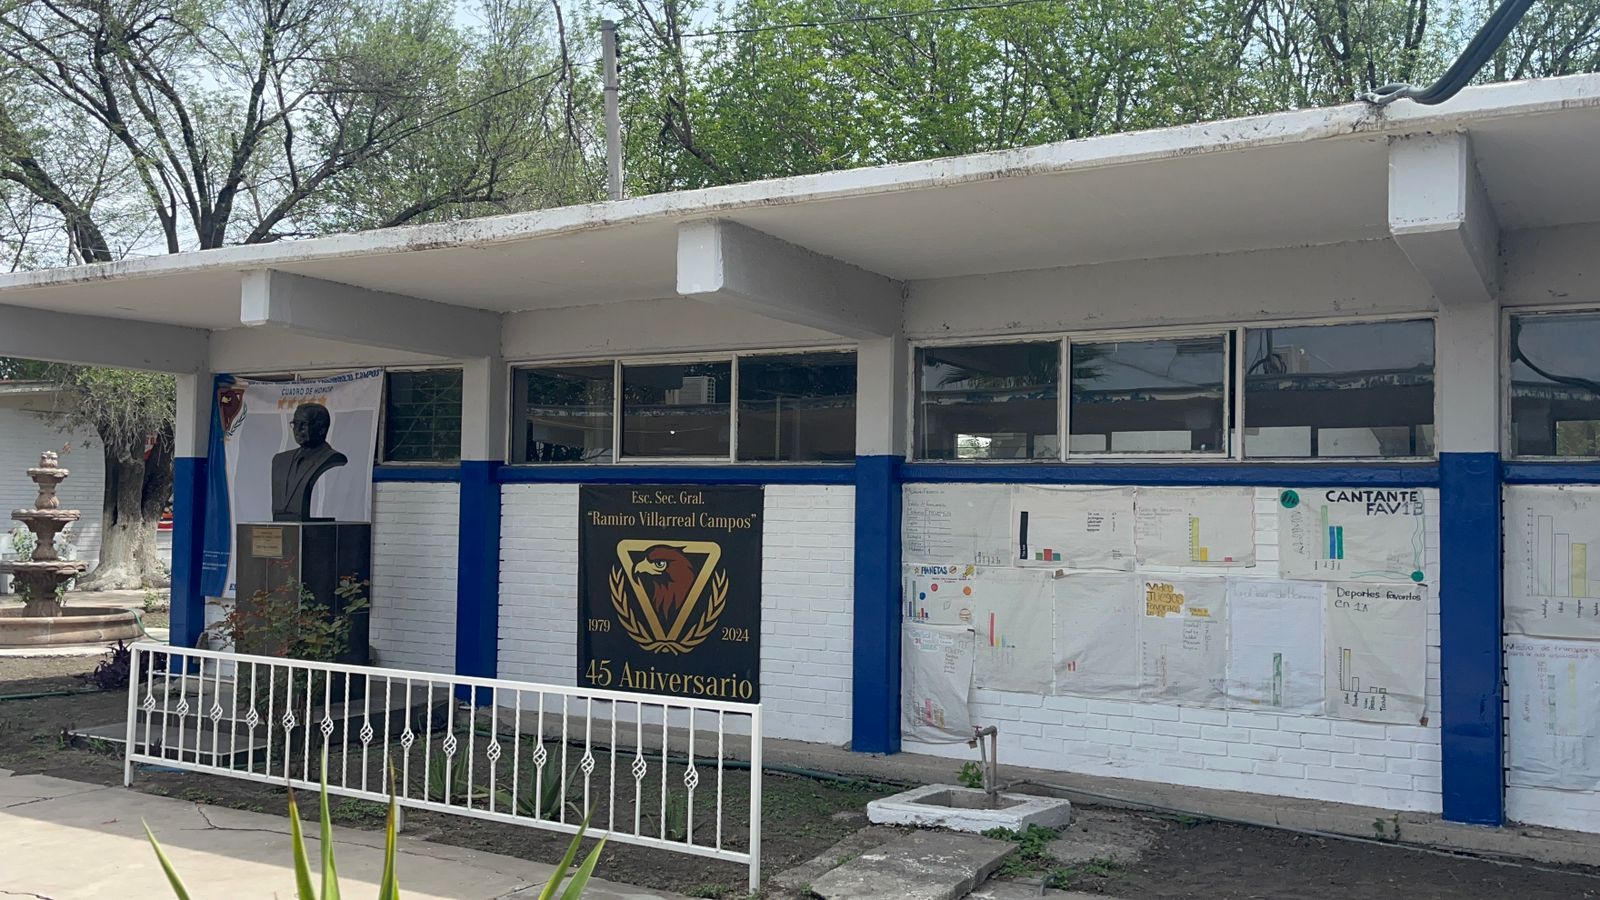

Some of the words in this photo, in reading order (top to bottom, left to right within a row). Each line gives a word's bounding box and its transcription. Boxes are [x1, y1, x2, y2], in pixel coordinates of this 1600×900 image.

[281, 387, 304, 396] CUADRO
[305, 386, 314, 395] DE
[632, 490, 652, 504] Esc.
[655, 491, 677, 504] Sec.
[679, 492, 705, 505] Gral.
[1325, 490, 1418, 503] CANTANTE
[587, 511, 636, 526] "Ramiro
[639, 512, 696, 527] Villarreal
[699, 512, 757, 532] Campos"
[1336, 586, 1381, 600] Deportes
[588, 618, 611, 632] 1979
[721, 627, 749, 642] 2024
[585, 659, 613, 686] 45
[618, 661, 753, 699] Aniversario
